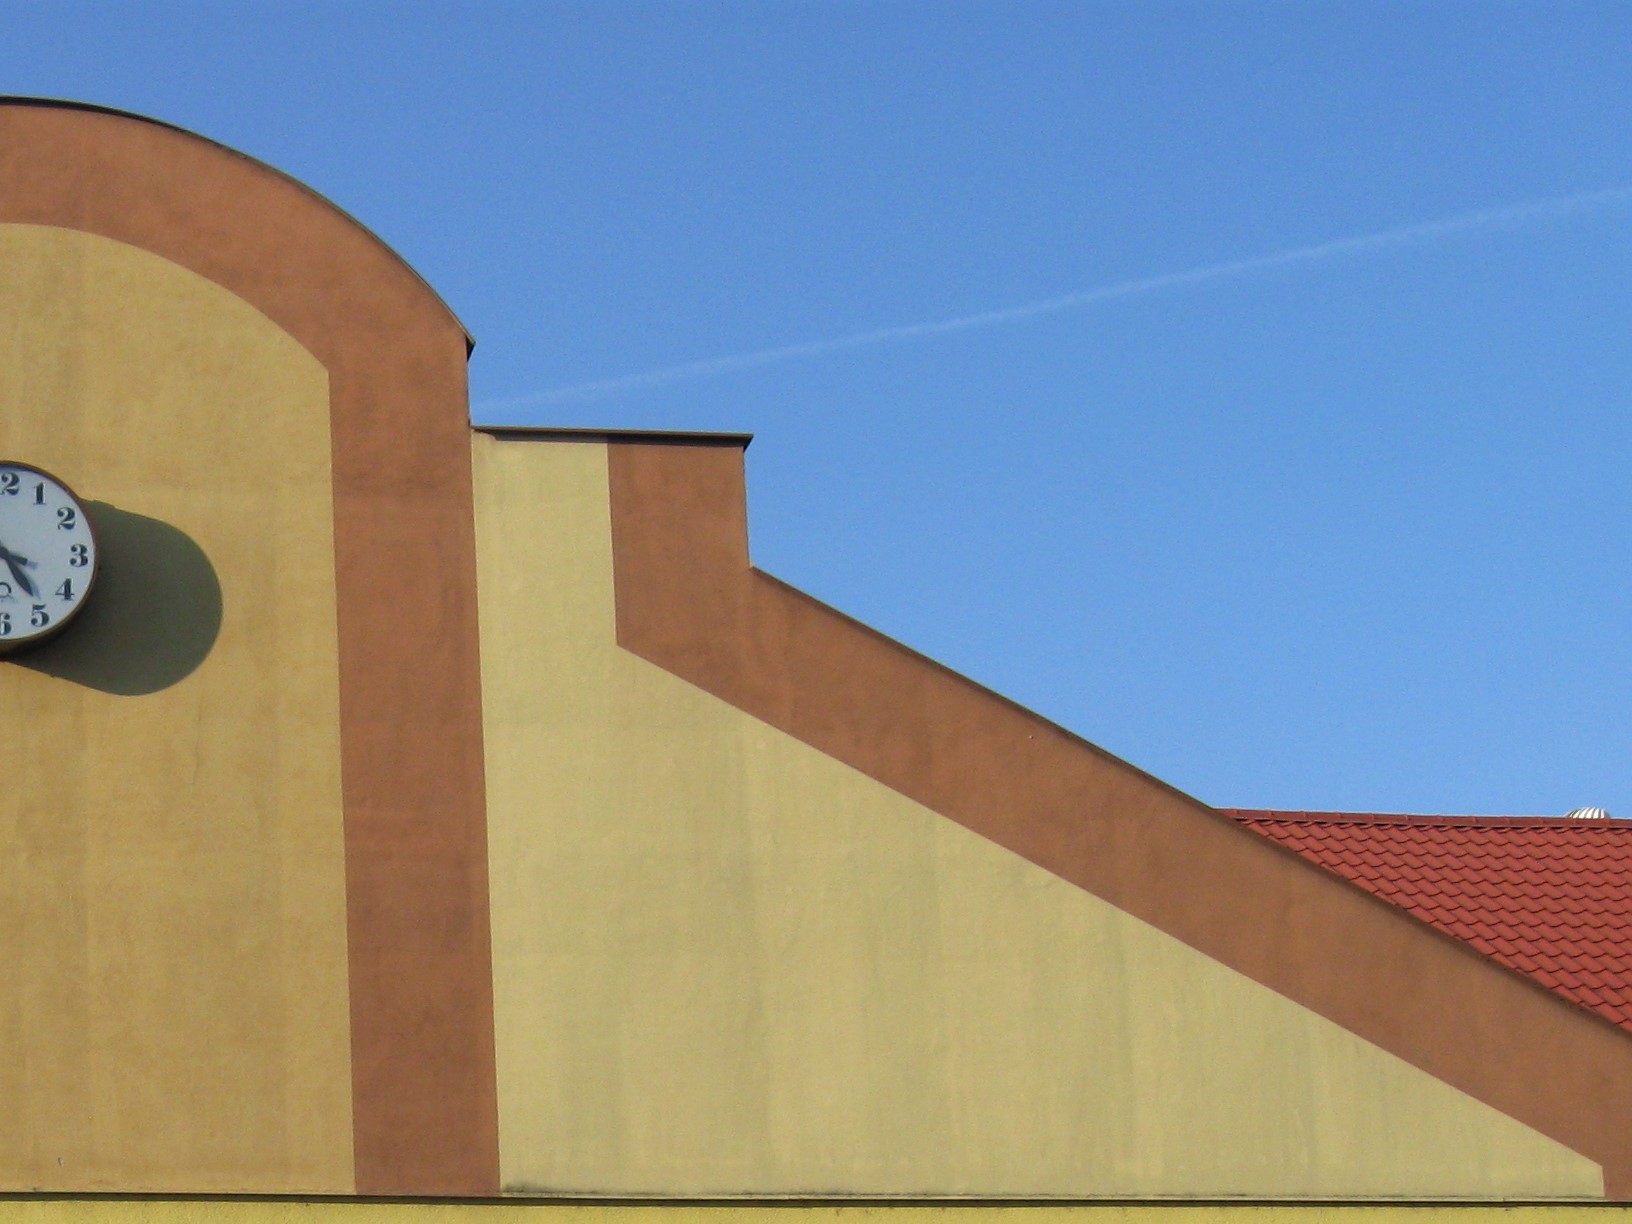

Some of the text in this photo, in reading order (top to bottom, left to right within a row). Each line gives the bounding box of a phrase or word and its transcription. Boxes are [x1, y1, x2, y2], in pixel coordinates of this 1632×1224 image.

[34, 481, 47, 505] 1
[56, 507, 76, 530] 2
[70, 543, 88, 567] 3
[55, 578, 75, 600] 4
[30, 603, 49, 627] 5
